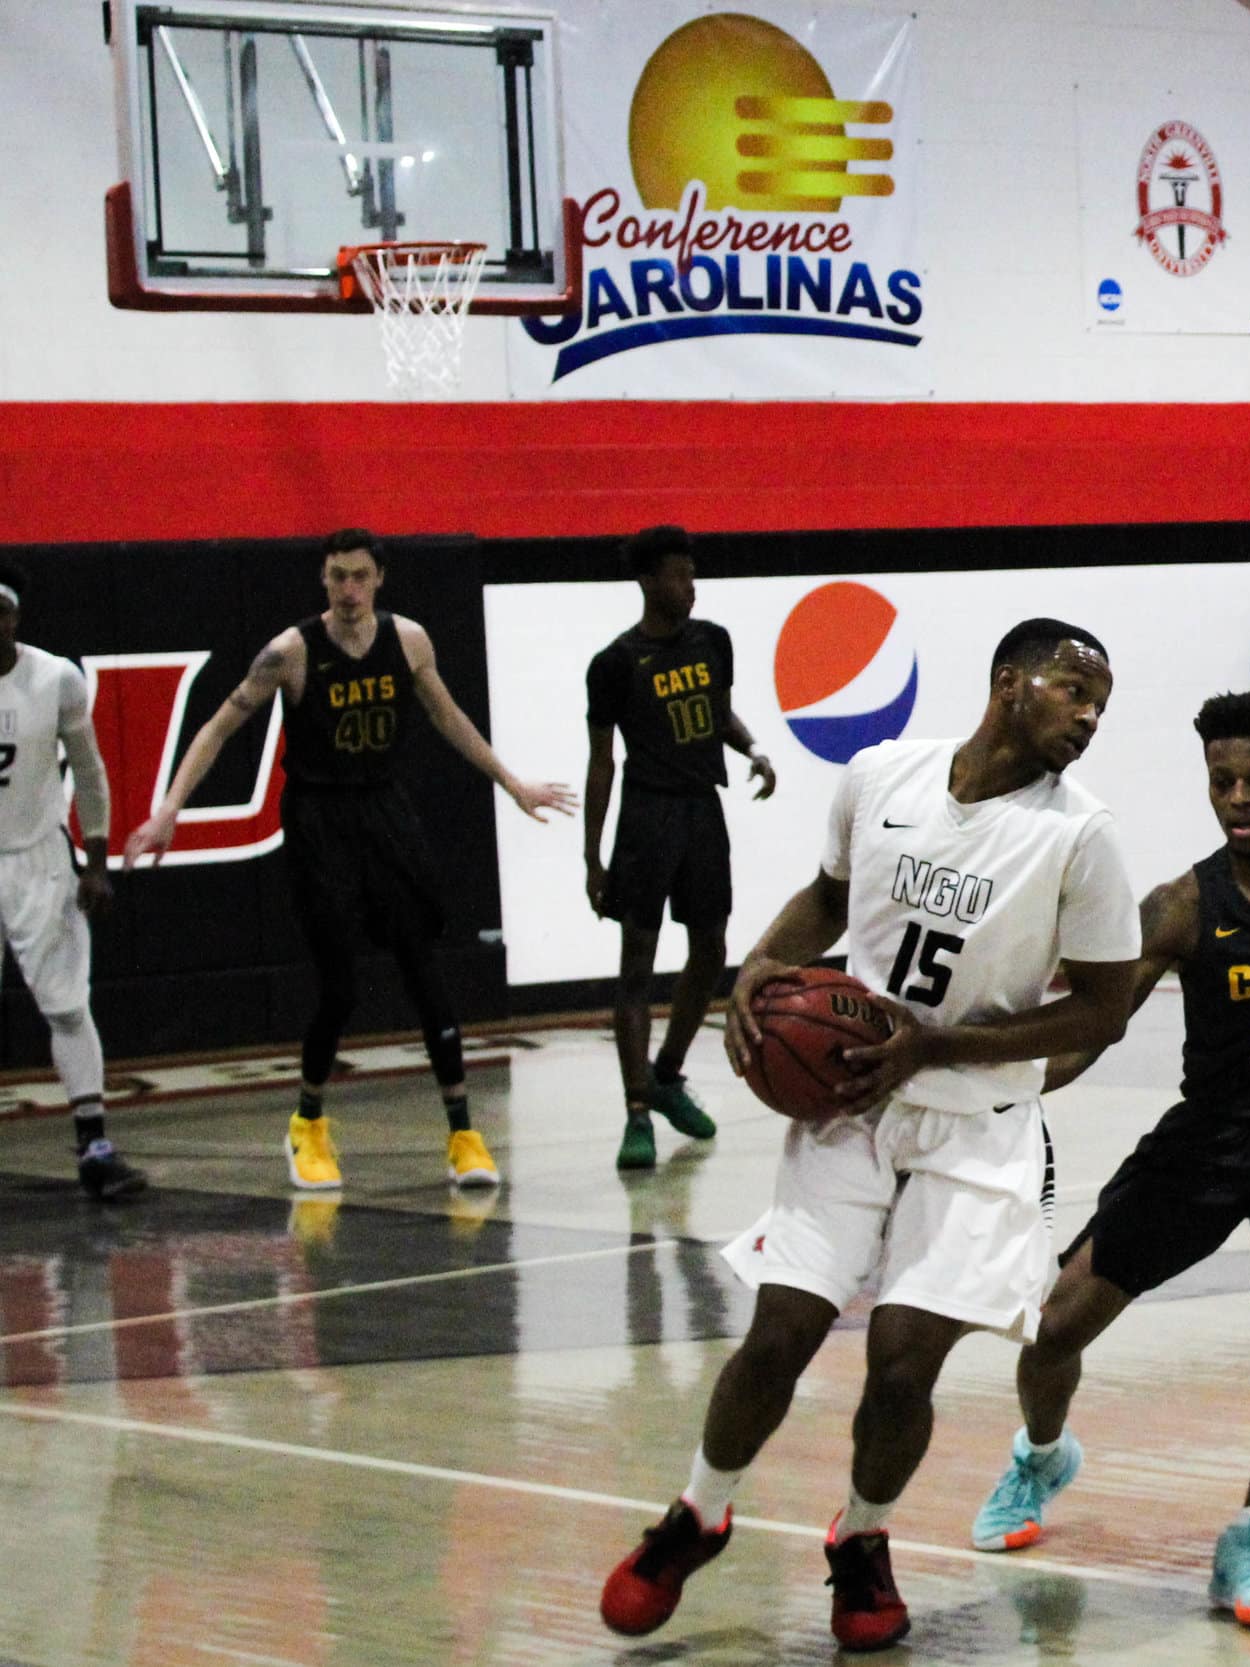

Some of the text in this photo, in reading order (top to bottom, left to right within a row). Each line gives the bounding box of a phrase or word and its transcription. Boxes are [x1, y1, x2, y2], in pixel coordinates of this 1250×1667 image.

[581, 188, 853, 272] Conference
[329, 674, 395, 708] CATS
[653, 662, 711, 697] CATS
[335, 706, 396, 753] 40
[667, 694, 714, 743] 10
[891, 853, 993, 924] NGU
[886, 920, 966, 1008] 15
